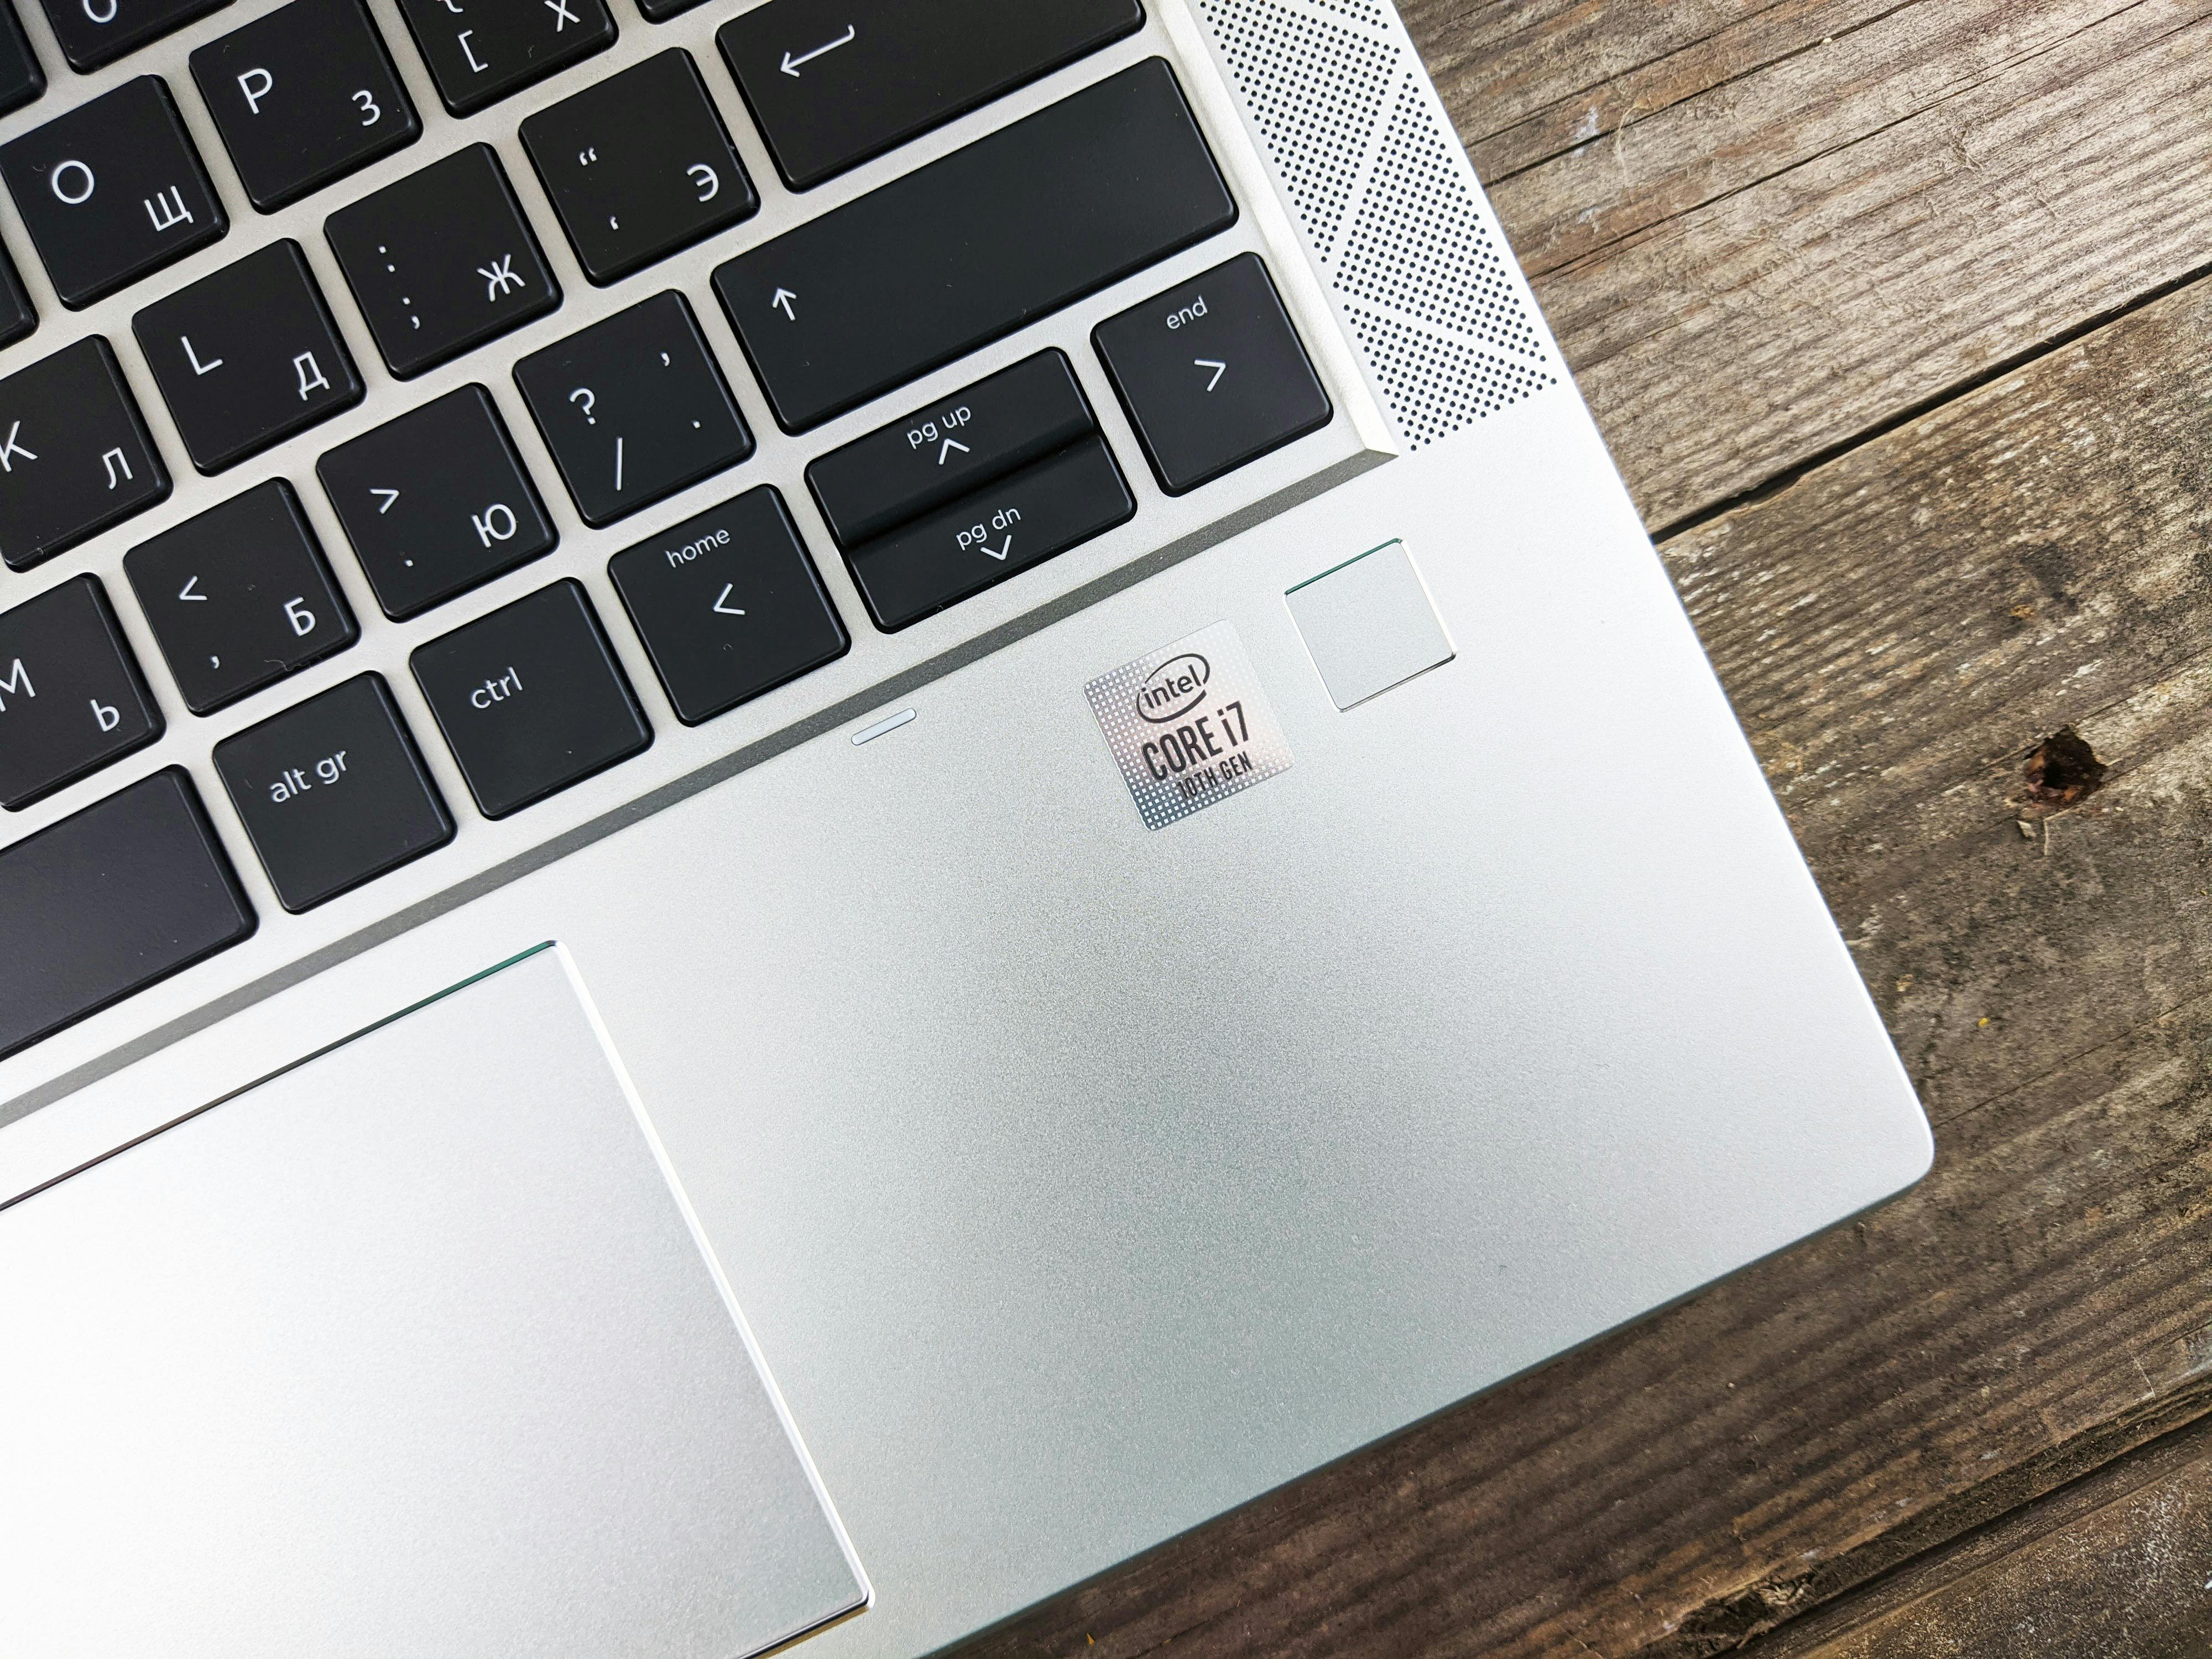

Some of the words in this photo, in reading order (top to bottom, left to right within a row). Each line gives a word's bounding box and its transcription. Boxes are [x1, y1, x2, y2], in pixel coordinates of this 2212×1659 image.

[458, 30, 488, 72] [
[238, 69, 272, 114] P
[687, 164, 718, 201] Э
[144, 186, 194, 231] Щ
[379, 246, 395, 273] :
[477, 254, 525, 301] Ж
[403, 298, 420, 329] ;
[1167, 296, 1207, 330] end
[181, 336, 222, 375] L
[294, 352, 330, 400] Д
[570, 388, 595, 424] ?
[0, 421, 38, 472] K
[907, 422, 938, 449] pg
[942, 406, 971, 428] up
[102, 447, 133, 489] Л
[616, 437, 623, 491] /
[472, 504, 517, 547] Ю
[956, 524, 987, 550] pg
[993, 508, 1021, 529] dn
[666, 529, 730, 567] home
[284, 597, 315, 636] Б
[472, 667, 522, 708] ctrl
[1141, 664, 1202, 709] intel
[1142, 716, 1223, 780] CORE
[1217, 700, 1249, 747] i7
[270, 769, 311, 802] alt
[316, 751, 346, 781] gr
[1177, 766, 1220, 799] 10TH
[1219, 751, 1253, 781] GEN
